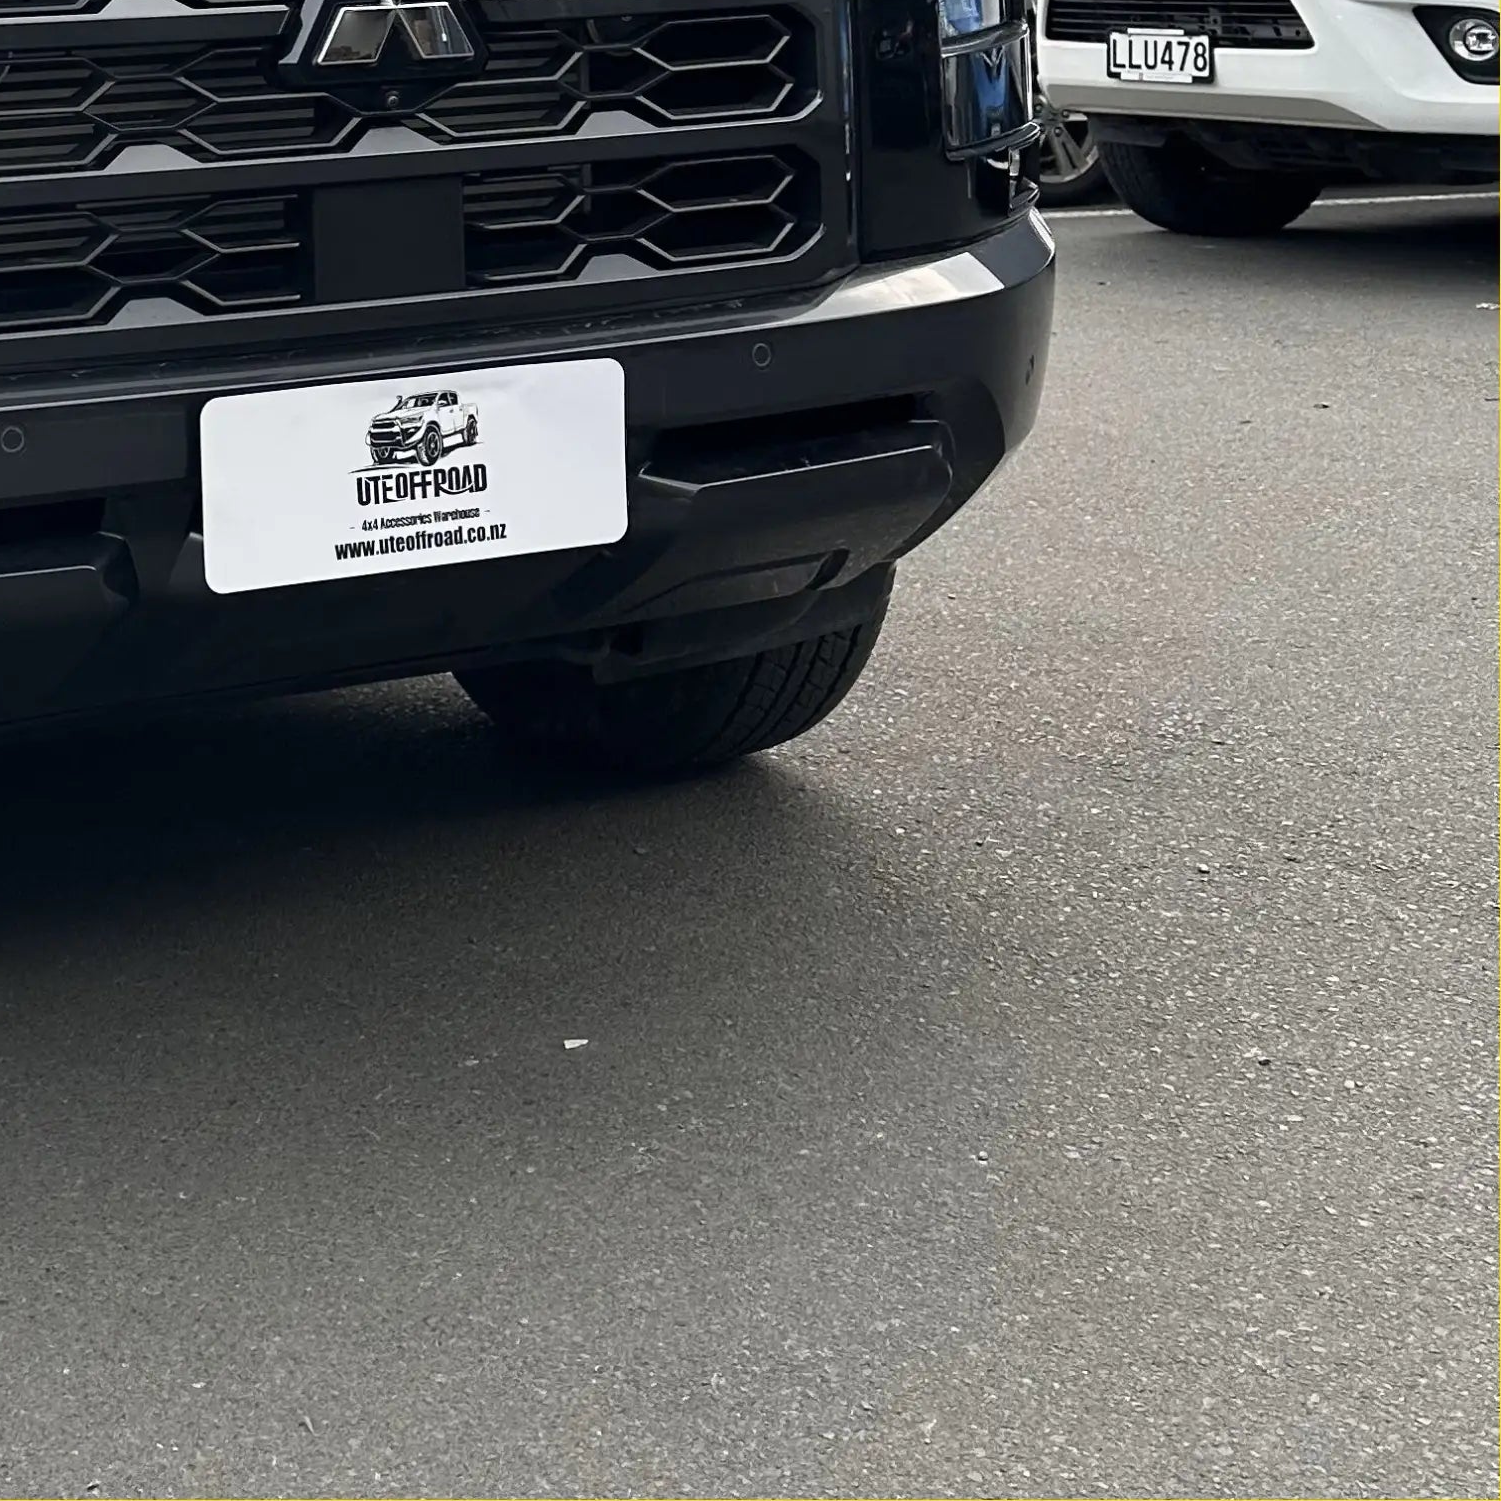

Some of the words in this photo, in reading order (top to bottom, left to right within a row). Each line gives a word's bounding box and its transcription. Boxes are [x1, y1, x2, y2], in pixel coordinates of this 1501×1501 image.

[1112, 38, 1208, 72] LLU478
[356, 463, 488, 507] UTEOFFROAD
[361, 517, 379, 532] 4x4
[380, 512, 433, 530] Accessories
[433, 507, 481, 523] Warehouse
[334, 523, 508, 561] www.uteoffroad.co.nz
